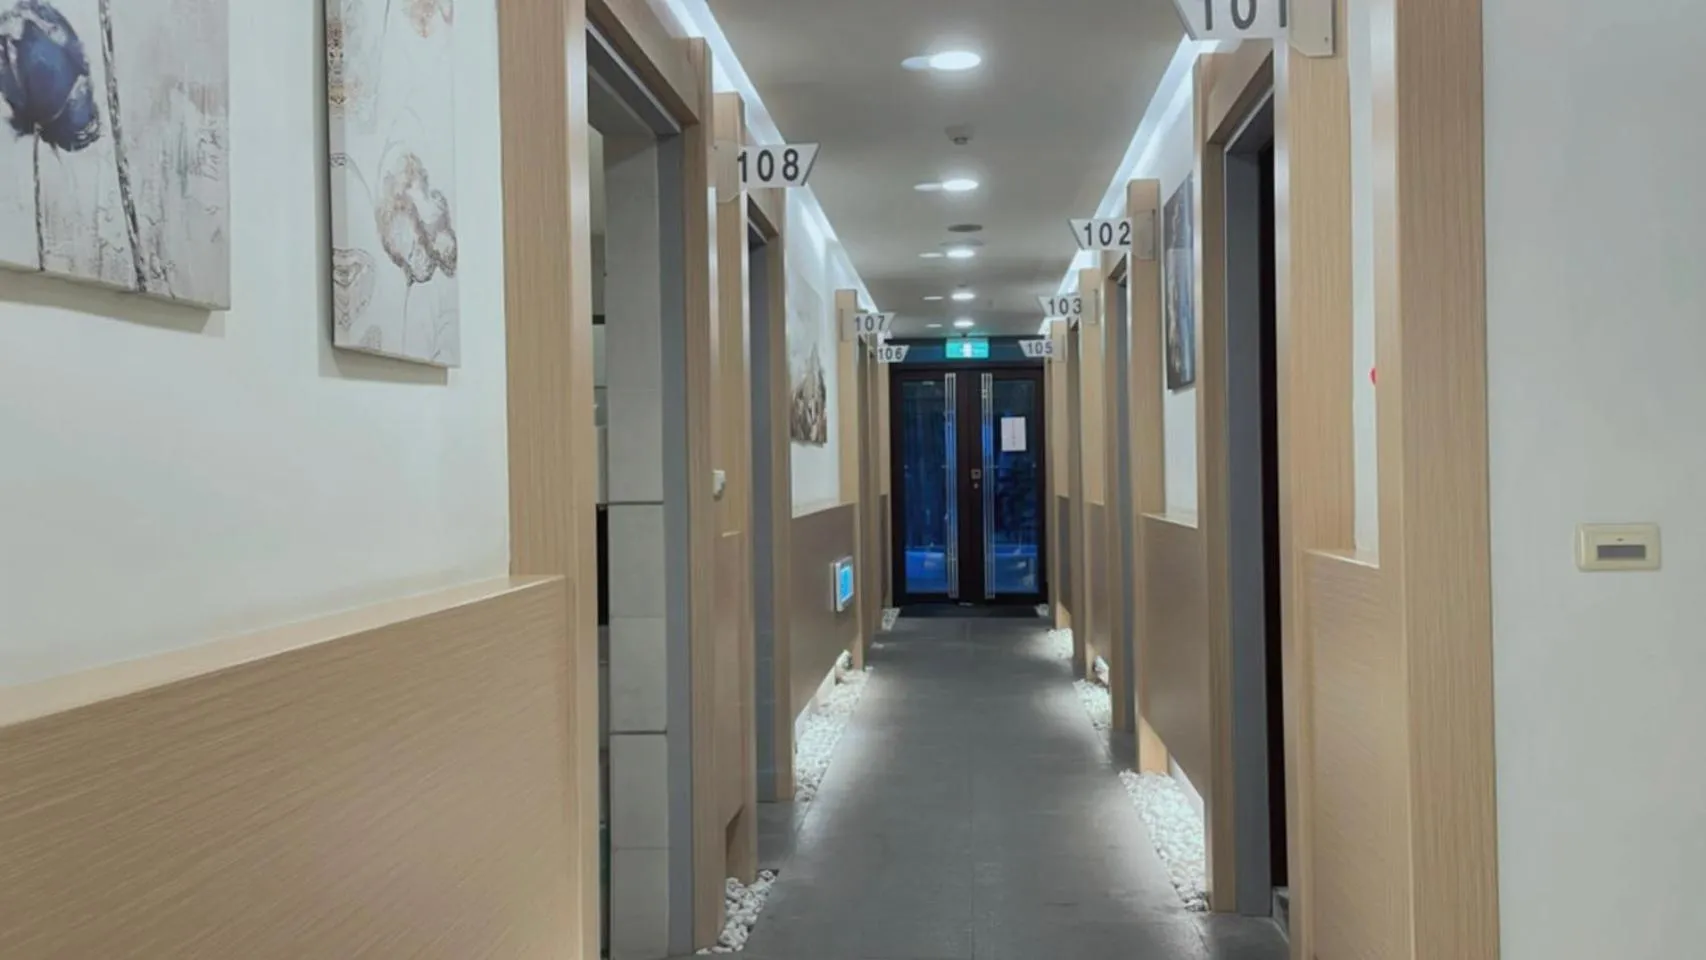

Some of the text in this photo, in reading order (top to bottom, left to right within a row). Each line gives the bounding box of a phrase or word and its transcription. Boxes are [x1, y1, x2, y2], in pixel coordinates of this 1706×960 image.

[737, 148, 800, 183] 108
[1083, 221, 1132, 246] 102
[1048, 298, 1082, 315] 103
[854, 315, 885, 331] 107
[878, 347, 904, 360] 106
[1027, 341, 1053, 354] 105
